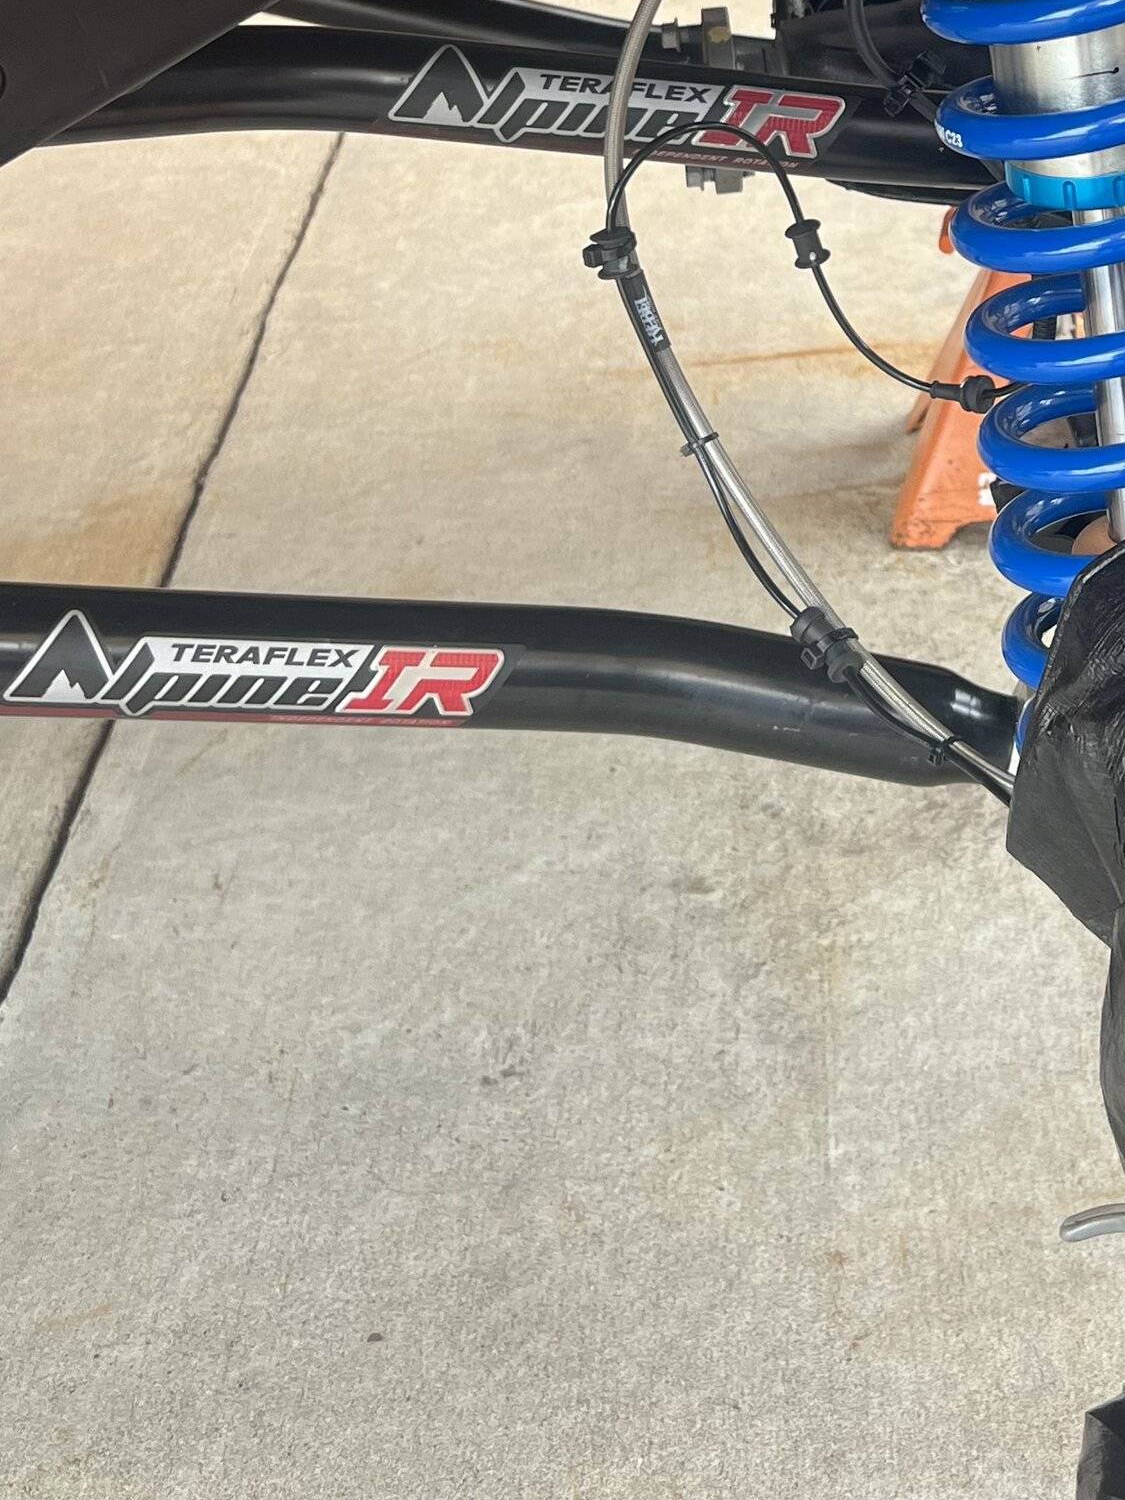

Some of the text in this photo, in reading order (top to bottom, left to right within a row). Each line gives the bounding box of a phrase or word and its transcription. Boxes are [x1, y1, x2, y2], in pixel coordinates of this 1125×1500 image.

[632, 149, 800, 169] IEPENDENT ROTAON
[171, 643, 361, 668] TERAFLEX
[335, 645, 504, 716] IR
